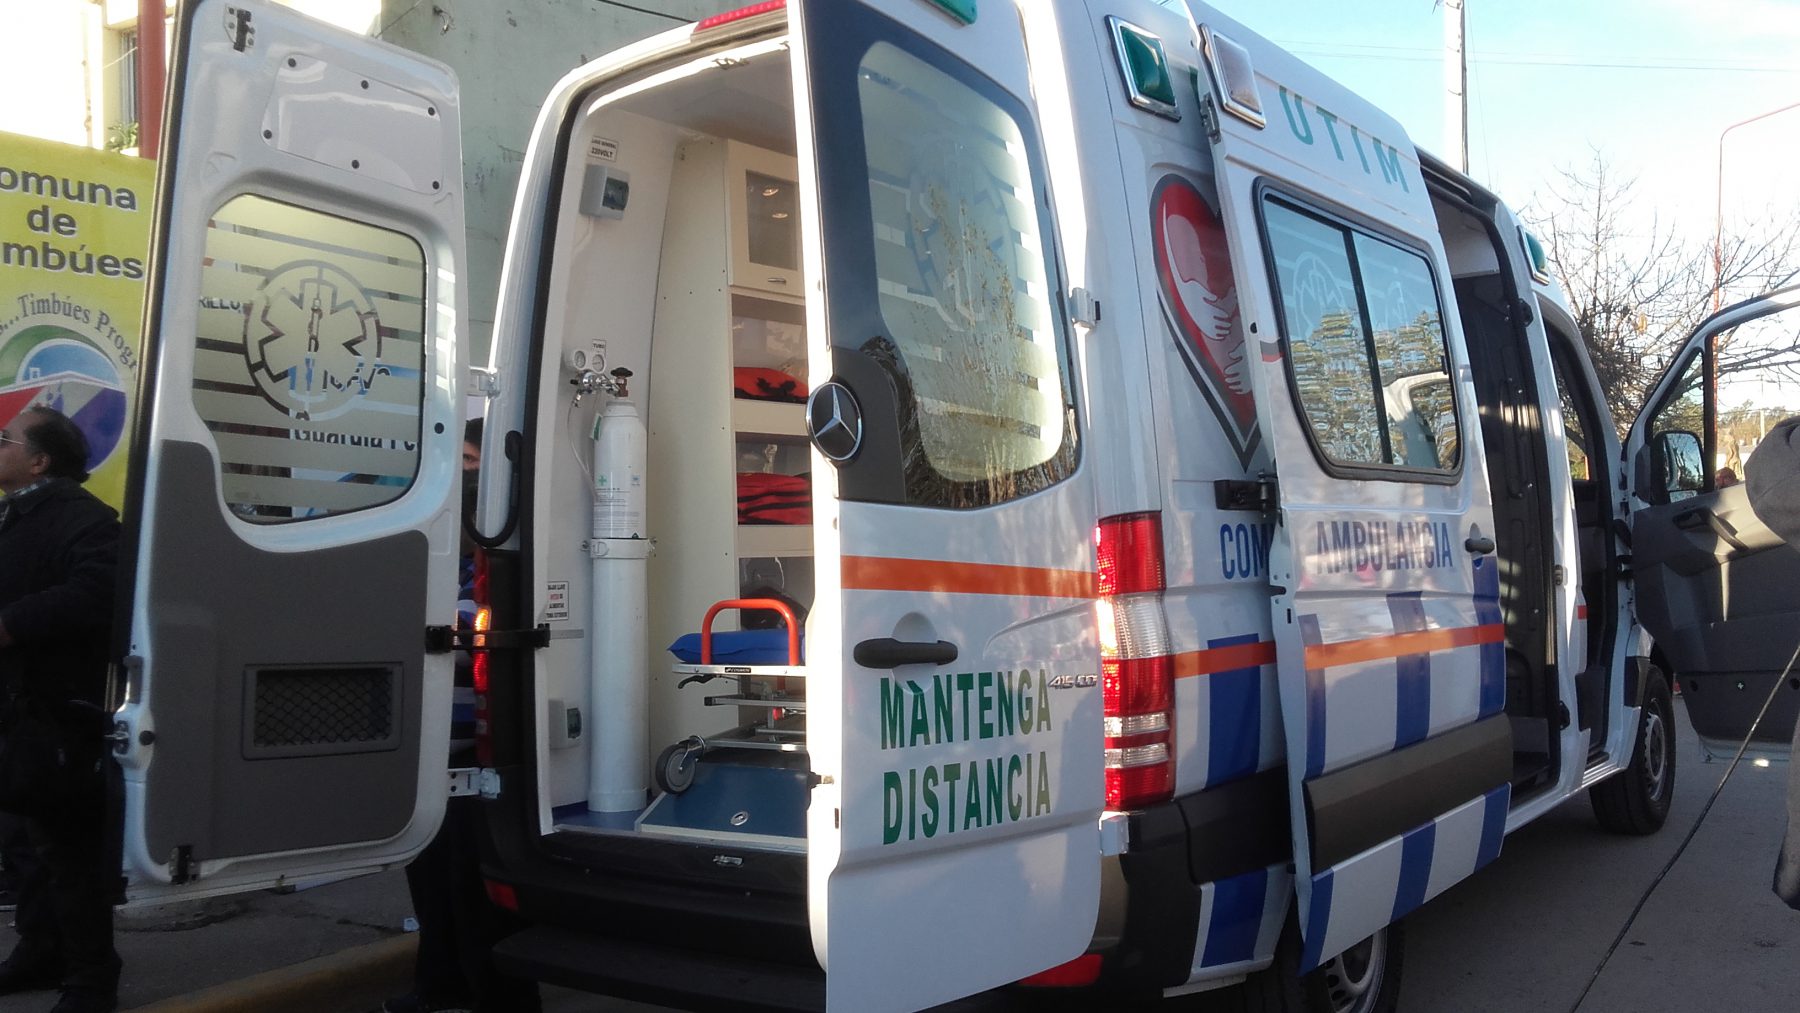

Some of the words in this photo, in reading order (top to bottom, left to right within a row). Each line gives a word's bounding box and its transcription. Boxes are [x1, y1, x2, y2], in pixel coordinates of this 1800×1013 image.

[1279, 84, 1410, 194] UTIM
[27, 205, 77, 236] de
[1316, 520, 1454, 574] AMBULANCIA
[880, 668, 1052, 750] MANTENGA
[883, 751, 1051, 845] DISTANCIA
